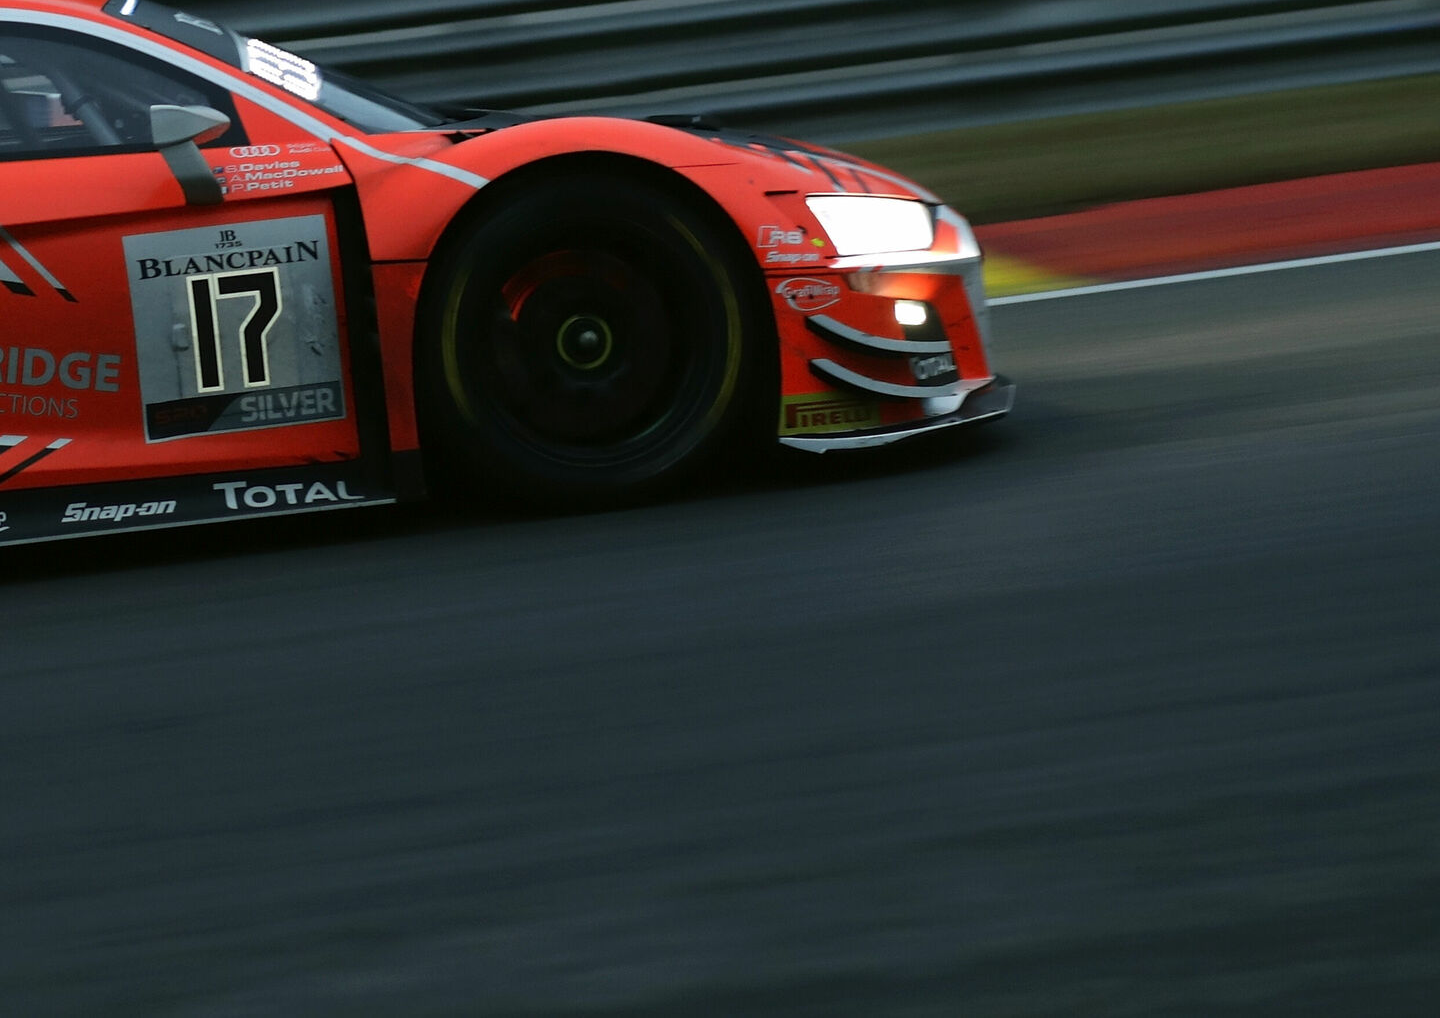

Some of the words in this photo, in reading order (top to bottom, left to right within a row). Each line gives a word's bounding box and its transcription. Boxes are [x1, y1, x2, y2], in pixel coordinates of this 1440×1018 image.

[218, 229, 237, 242] JB
[137, 240, 320, 280] BLANCPAIN
[186, 266, 283, 393] 17
[240, 387, 336, 422] SILVER
[61, 499, 178, 523] Snap-on
[213, 480, 366, 510] TOTAL
